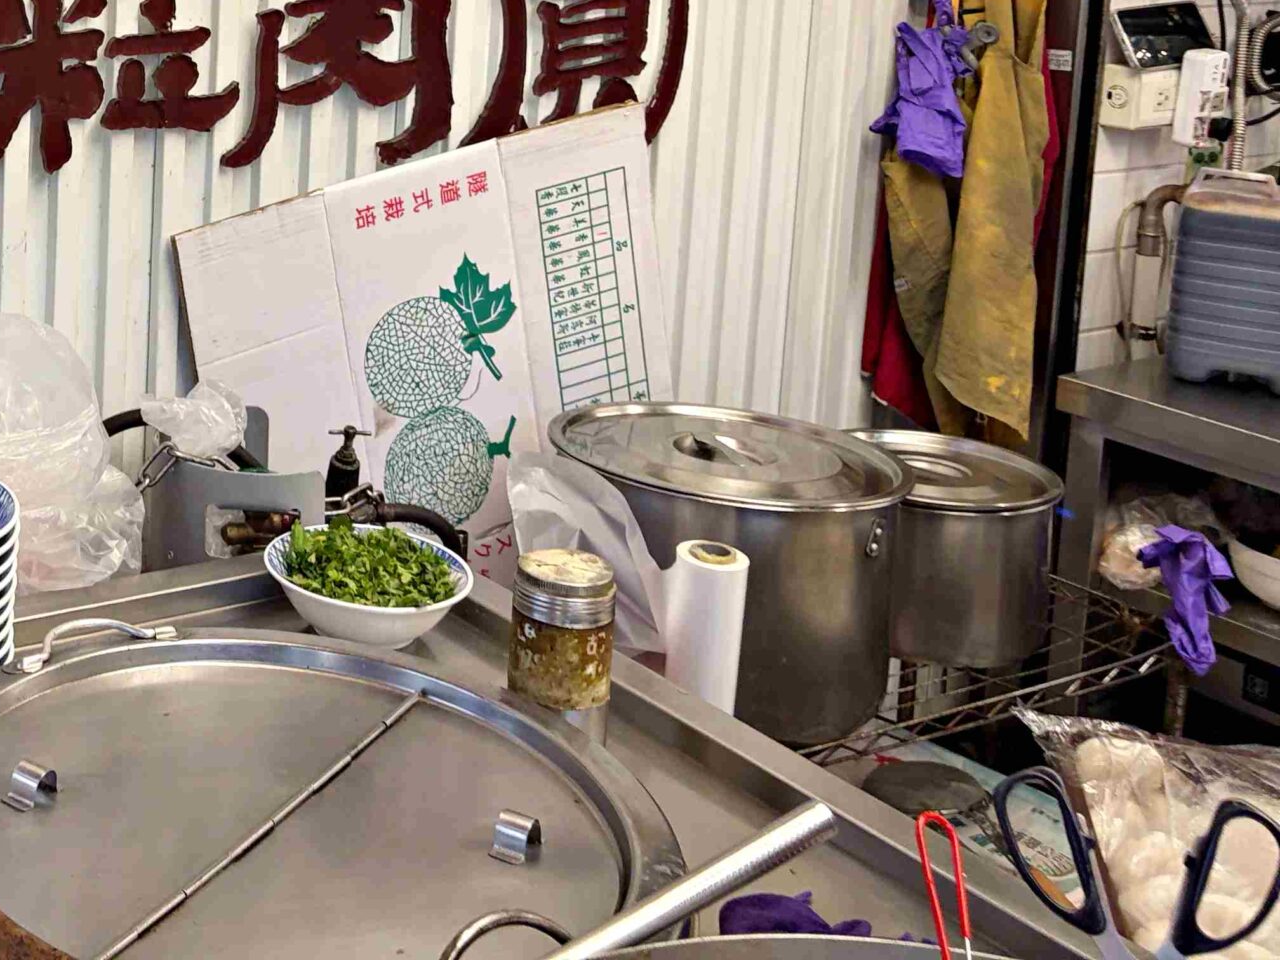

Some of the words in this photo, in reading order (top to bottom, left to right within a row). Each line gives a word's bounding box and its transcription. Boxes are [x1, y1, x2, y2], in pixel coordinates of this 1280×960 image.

[355, 170, 489, 230] 隧道式栽培
